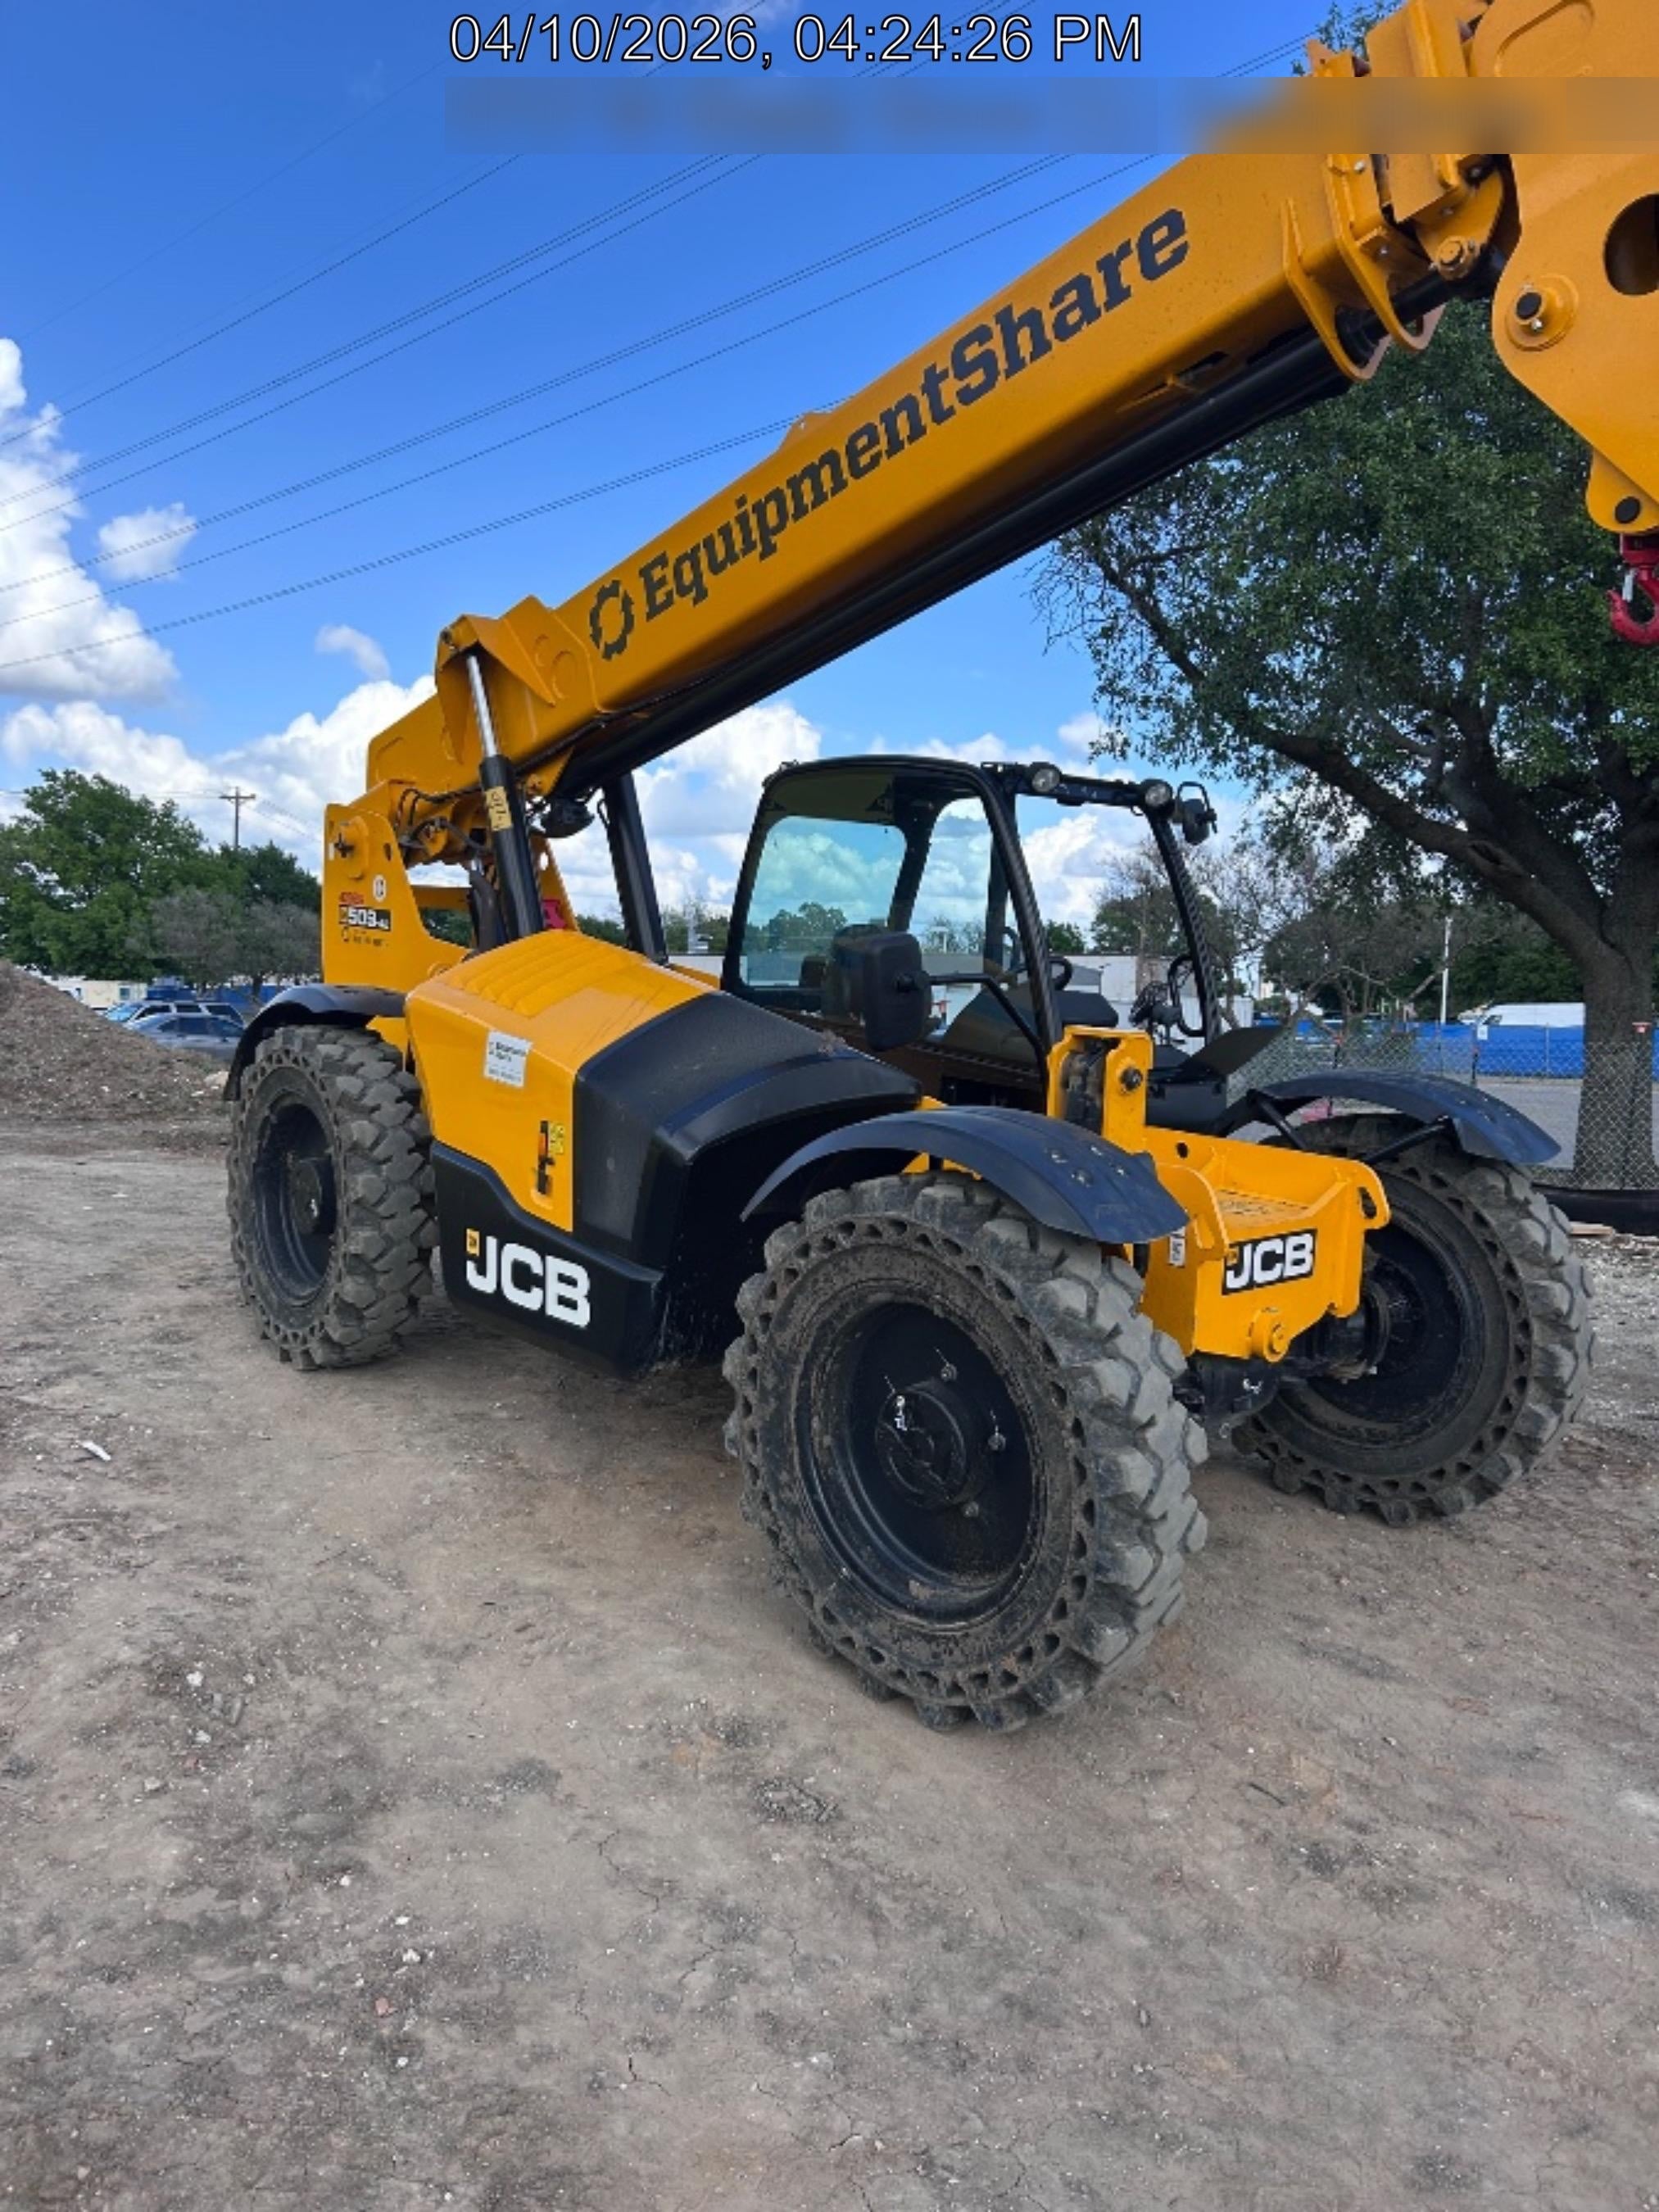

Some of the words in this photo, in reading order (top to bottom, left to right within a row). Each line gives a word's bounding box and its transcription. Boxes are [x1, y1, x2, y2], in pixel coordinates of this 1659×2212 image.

[638, 208, 1190, 622] EquipmentShare
[466, 1235, 591, 1327] JCB
[1226, 1232, 1314, 1290] JCB
